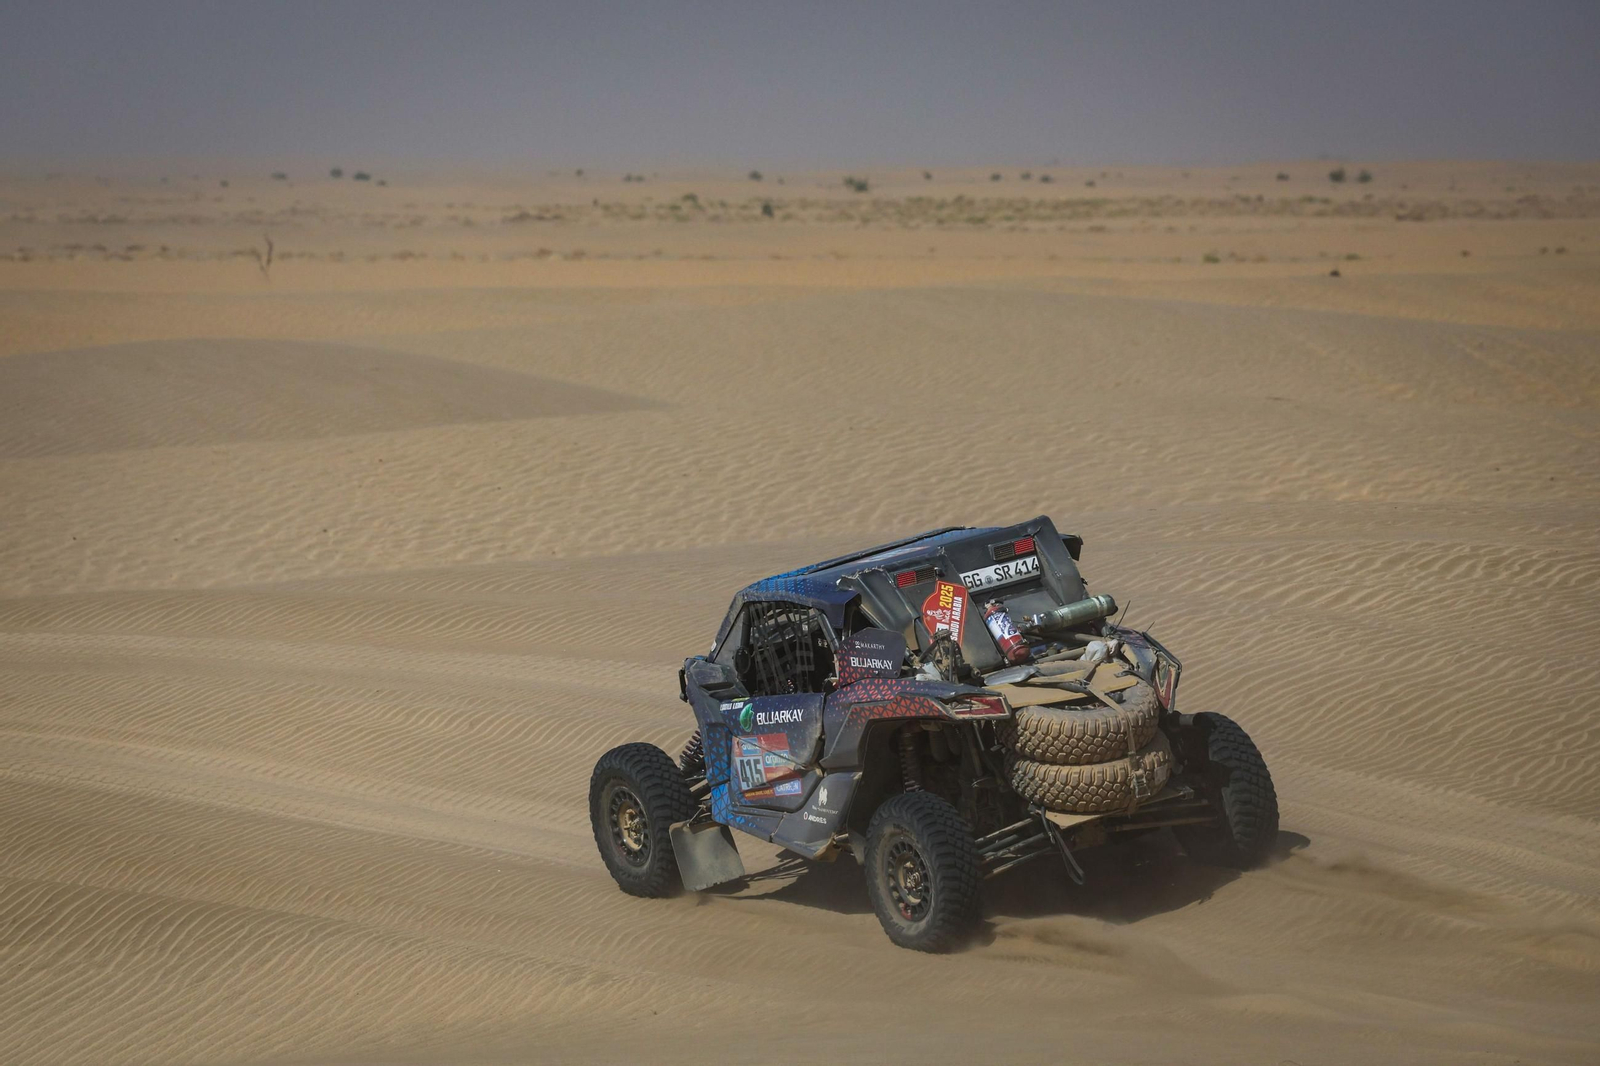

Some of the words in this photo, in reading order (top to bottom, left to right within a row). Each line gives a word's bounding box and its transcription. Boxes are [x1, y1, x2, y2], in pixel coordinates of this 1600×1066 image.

[962, 572, 983, 590] GG
[993, 564, 1013, 582] SR
[1014, 557, 1040, 576] 414
[939, 584, 954, 609] 2025
[951, 596, 963, 621] ARABIA
[850, 656, 893, 670] BUJARKAY
[756, 708, 804, 726] BUJARKAY
[739, 758, 764, 788] 415
